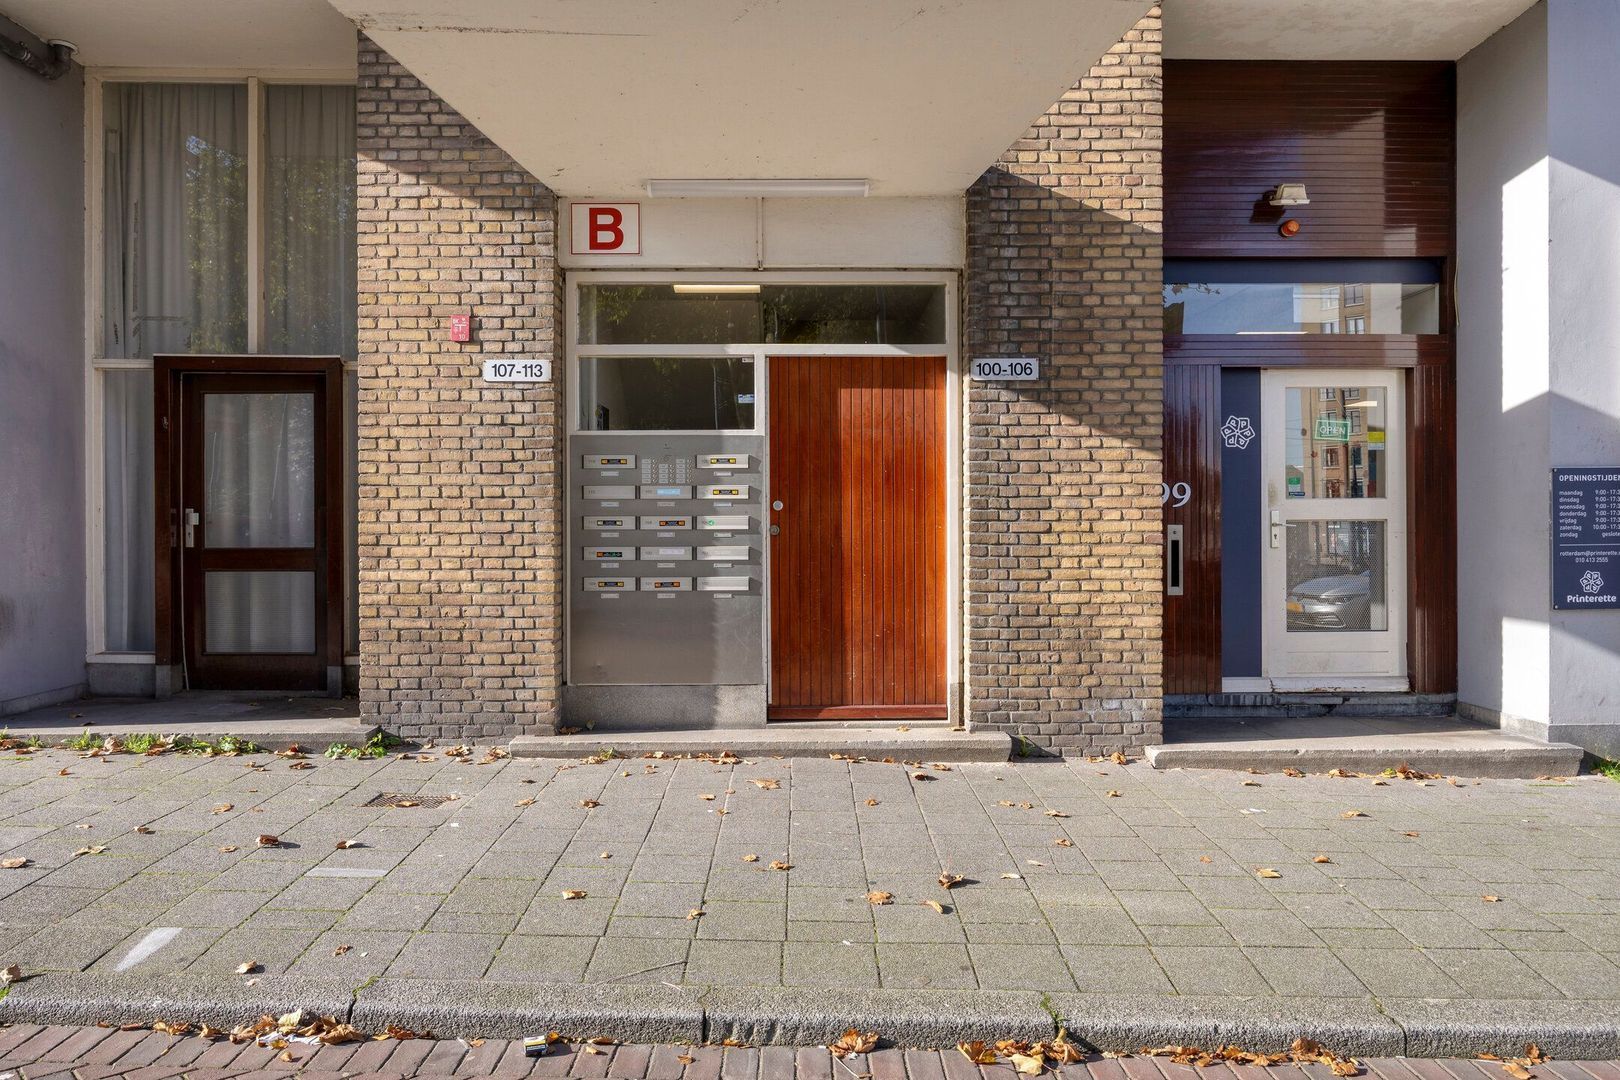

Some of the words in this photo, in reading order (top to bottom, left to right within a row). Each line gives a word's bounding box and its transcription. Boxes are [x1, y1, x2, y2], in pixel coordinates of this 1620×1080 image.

[588, 207, 624, 250] B
[491, 363, 543, 377] 107-113
[976, 362, 1033, 376] 100-106
[1320, 426, 1346, 434] OPEN
[1567, 594, 1617, 602] Printerette
